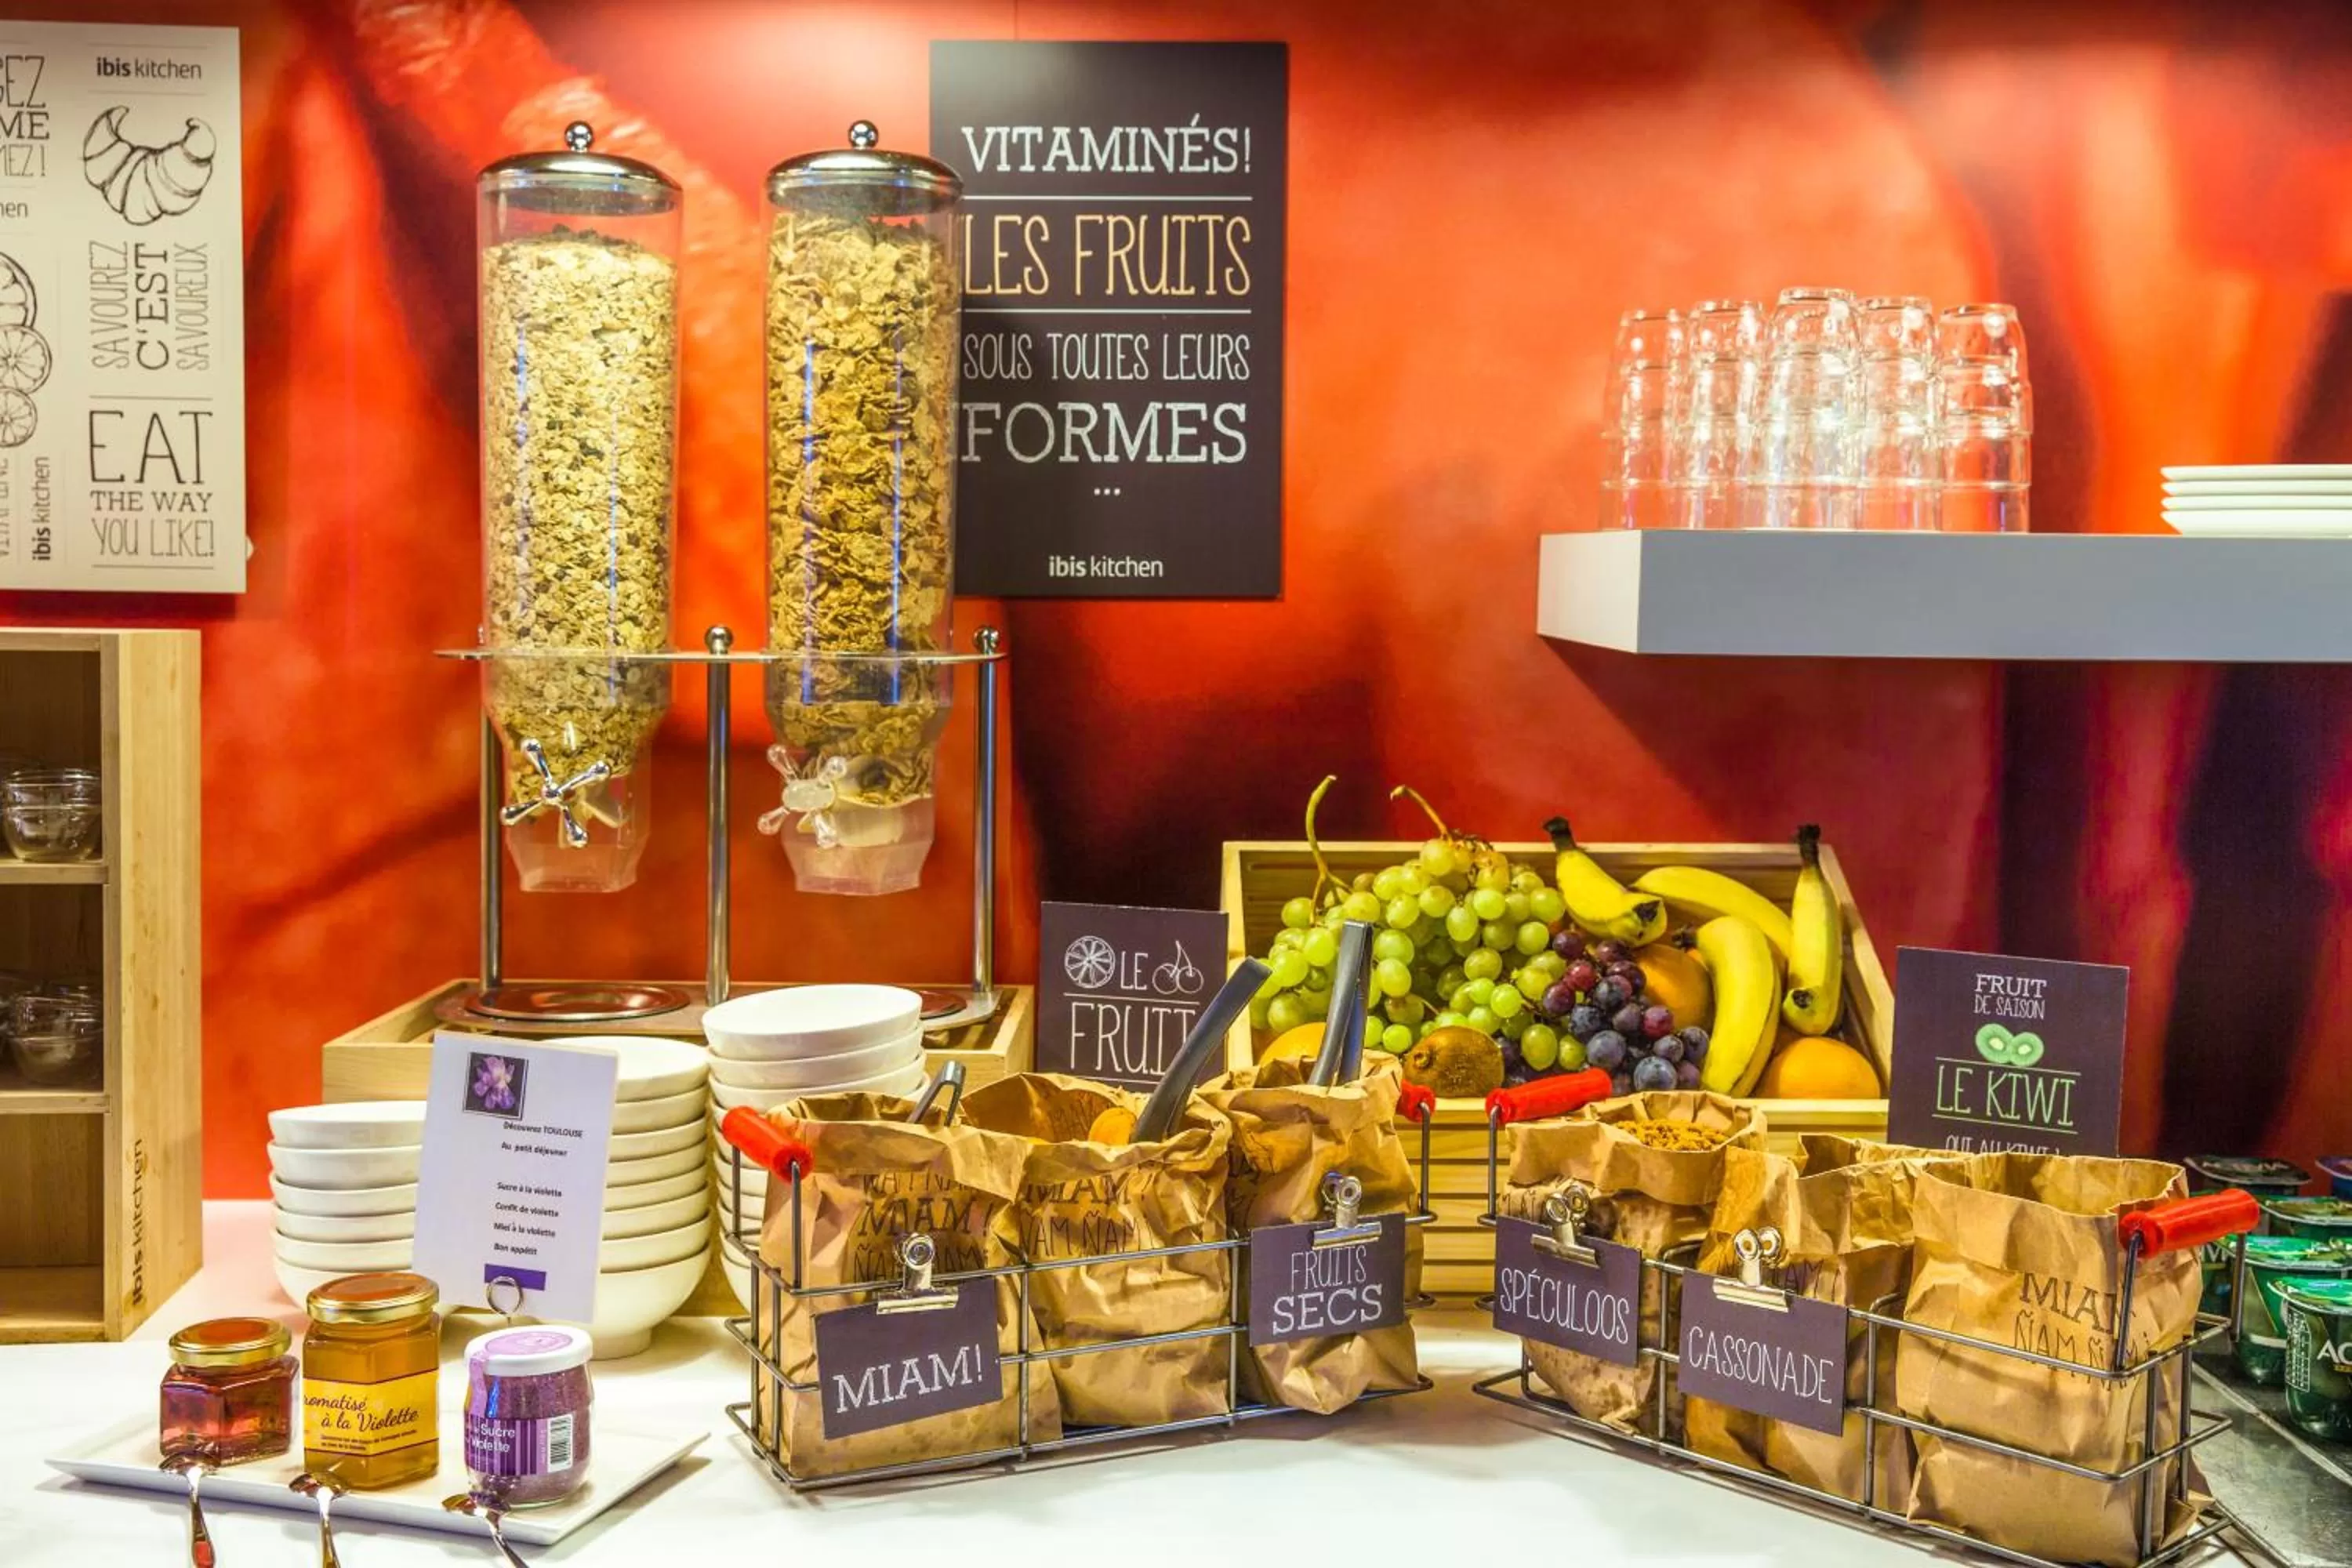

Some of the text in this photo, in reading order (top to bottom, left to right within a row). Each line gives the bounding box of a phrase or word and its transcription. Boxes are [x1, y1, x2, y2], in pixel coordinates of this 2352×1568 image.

[96, 57, 202, 79] ibis kitchen
[960, 112, 1251, 174] VITAMINÉS!
[964, 214, 1252, 297] LES FRUITS
[89, 239, 130, 370] SAVOUREZ
[134, 241, 170, 371] C'EST
[173, 241, 211, 372] SAVOUREUX
[963, 332, 1251, 381] SOUS TOUTES LEURS
[89, 409, 214, 485] EAT
[960, 401, 1248, 465] FORMES
[31, 456, 52, 561] ibis kitchen
[89, 490, 213, 513] THE WAY
[90, 517, 216, 557] YOU LIKE!
[1048, 555, 1164, 578] ibis kitchen
[1120, 949, 1149, 991] LE
[1974, 972, 2048, 1000] FRUIT
[1973, 993, 2046, 1021] DE SAISON
[1936, 1063, 2078, 1128] LE KIWI
[501, 1141, 512, 1150] Au
[514, 1145, 532, 1153] petit
[543, 1125, 584, 1138] TOULOUSE
[497, 1181, 518, 1192] Sucre
[534, 1186, 562, 1197] violette
[519, 1205, 529, 1214] de
[530, 1207, 559, 1218] violette
[494, 1222, 510, 1232] Miel
[527, 1226, 556, 1237] violette
[494, 1243, 509, 1252] Bon
[1290, 1244, 1367, 1293] FRUITS
[1272, 1283, 1384, 1335] SECS
[1499, 1267, 1630, 1346] SPÉCULOOS
[831, 1345, 983, 1414] MIAM!
[1686, 1324, 1835, 1405] CASSONADE
[320, 1407, 419, 1432] à la Violette
[481, 1423, 516, 1438] Sucre
